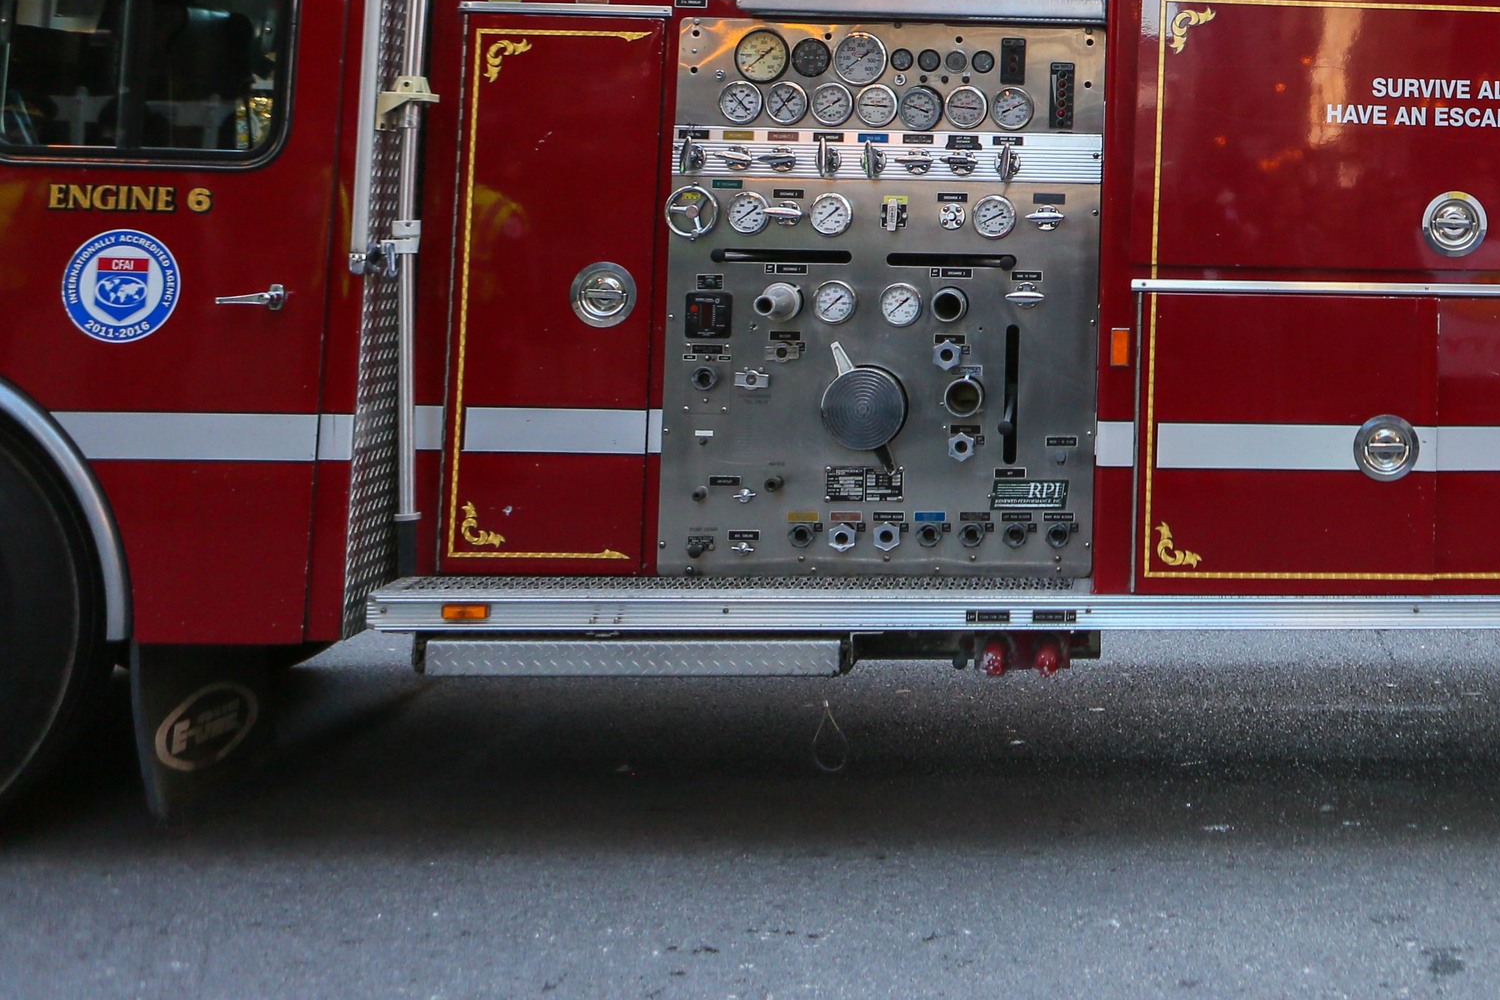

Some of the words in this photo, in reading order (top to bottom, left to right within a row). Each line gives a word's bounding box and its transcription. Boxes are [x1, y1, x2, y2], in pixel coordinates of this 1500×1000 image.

[1371, 77, 1471, 99] SURVIVE
[1326, 104, 1388, 125] HAVE
[1393, 106, 1427, 126] AN
[48, 184, 176, 212] ENGINE
[187, 187, 213, 213] 6
[68, 235, 116, 304] INTERNATIONALLY
[119, 234, 170, 267] ACCREDITED
[162, 269, 176, 308] AGENCY
[111, 259, 134, 270] CFAI
[84, 319, 151, 338] 2011-2016
[1028, 482, 1061, 499] RPI
